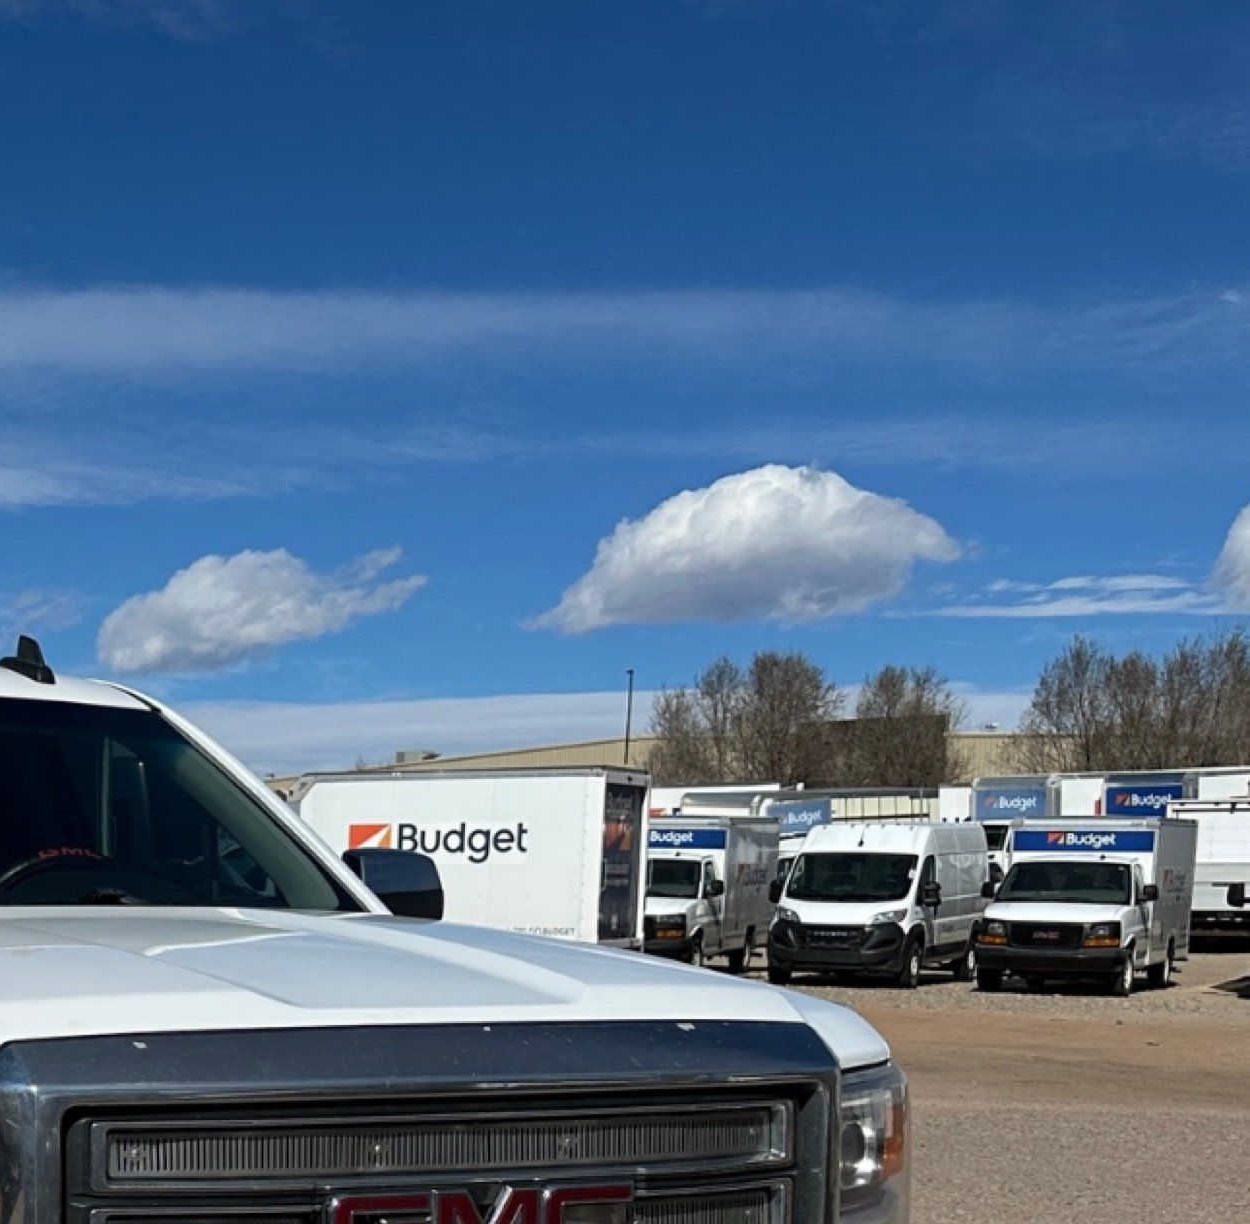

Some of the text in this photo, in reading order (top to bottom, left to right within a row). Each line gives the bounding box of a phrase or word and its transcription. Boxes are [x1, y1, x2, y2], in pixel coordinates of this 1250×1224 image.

[999, 796, 1037, 812] Budget
[397, 823, 528, 863] Budget
[650, 831, 693, 845] Budget
[1065, 832, 1116, 849] Budget
